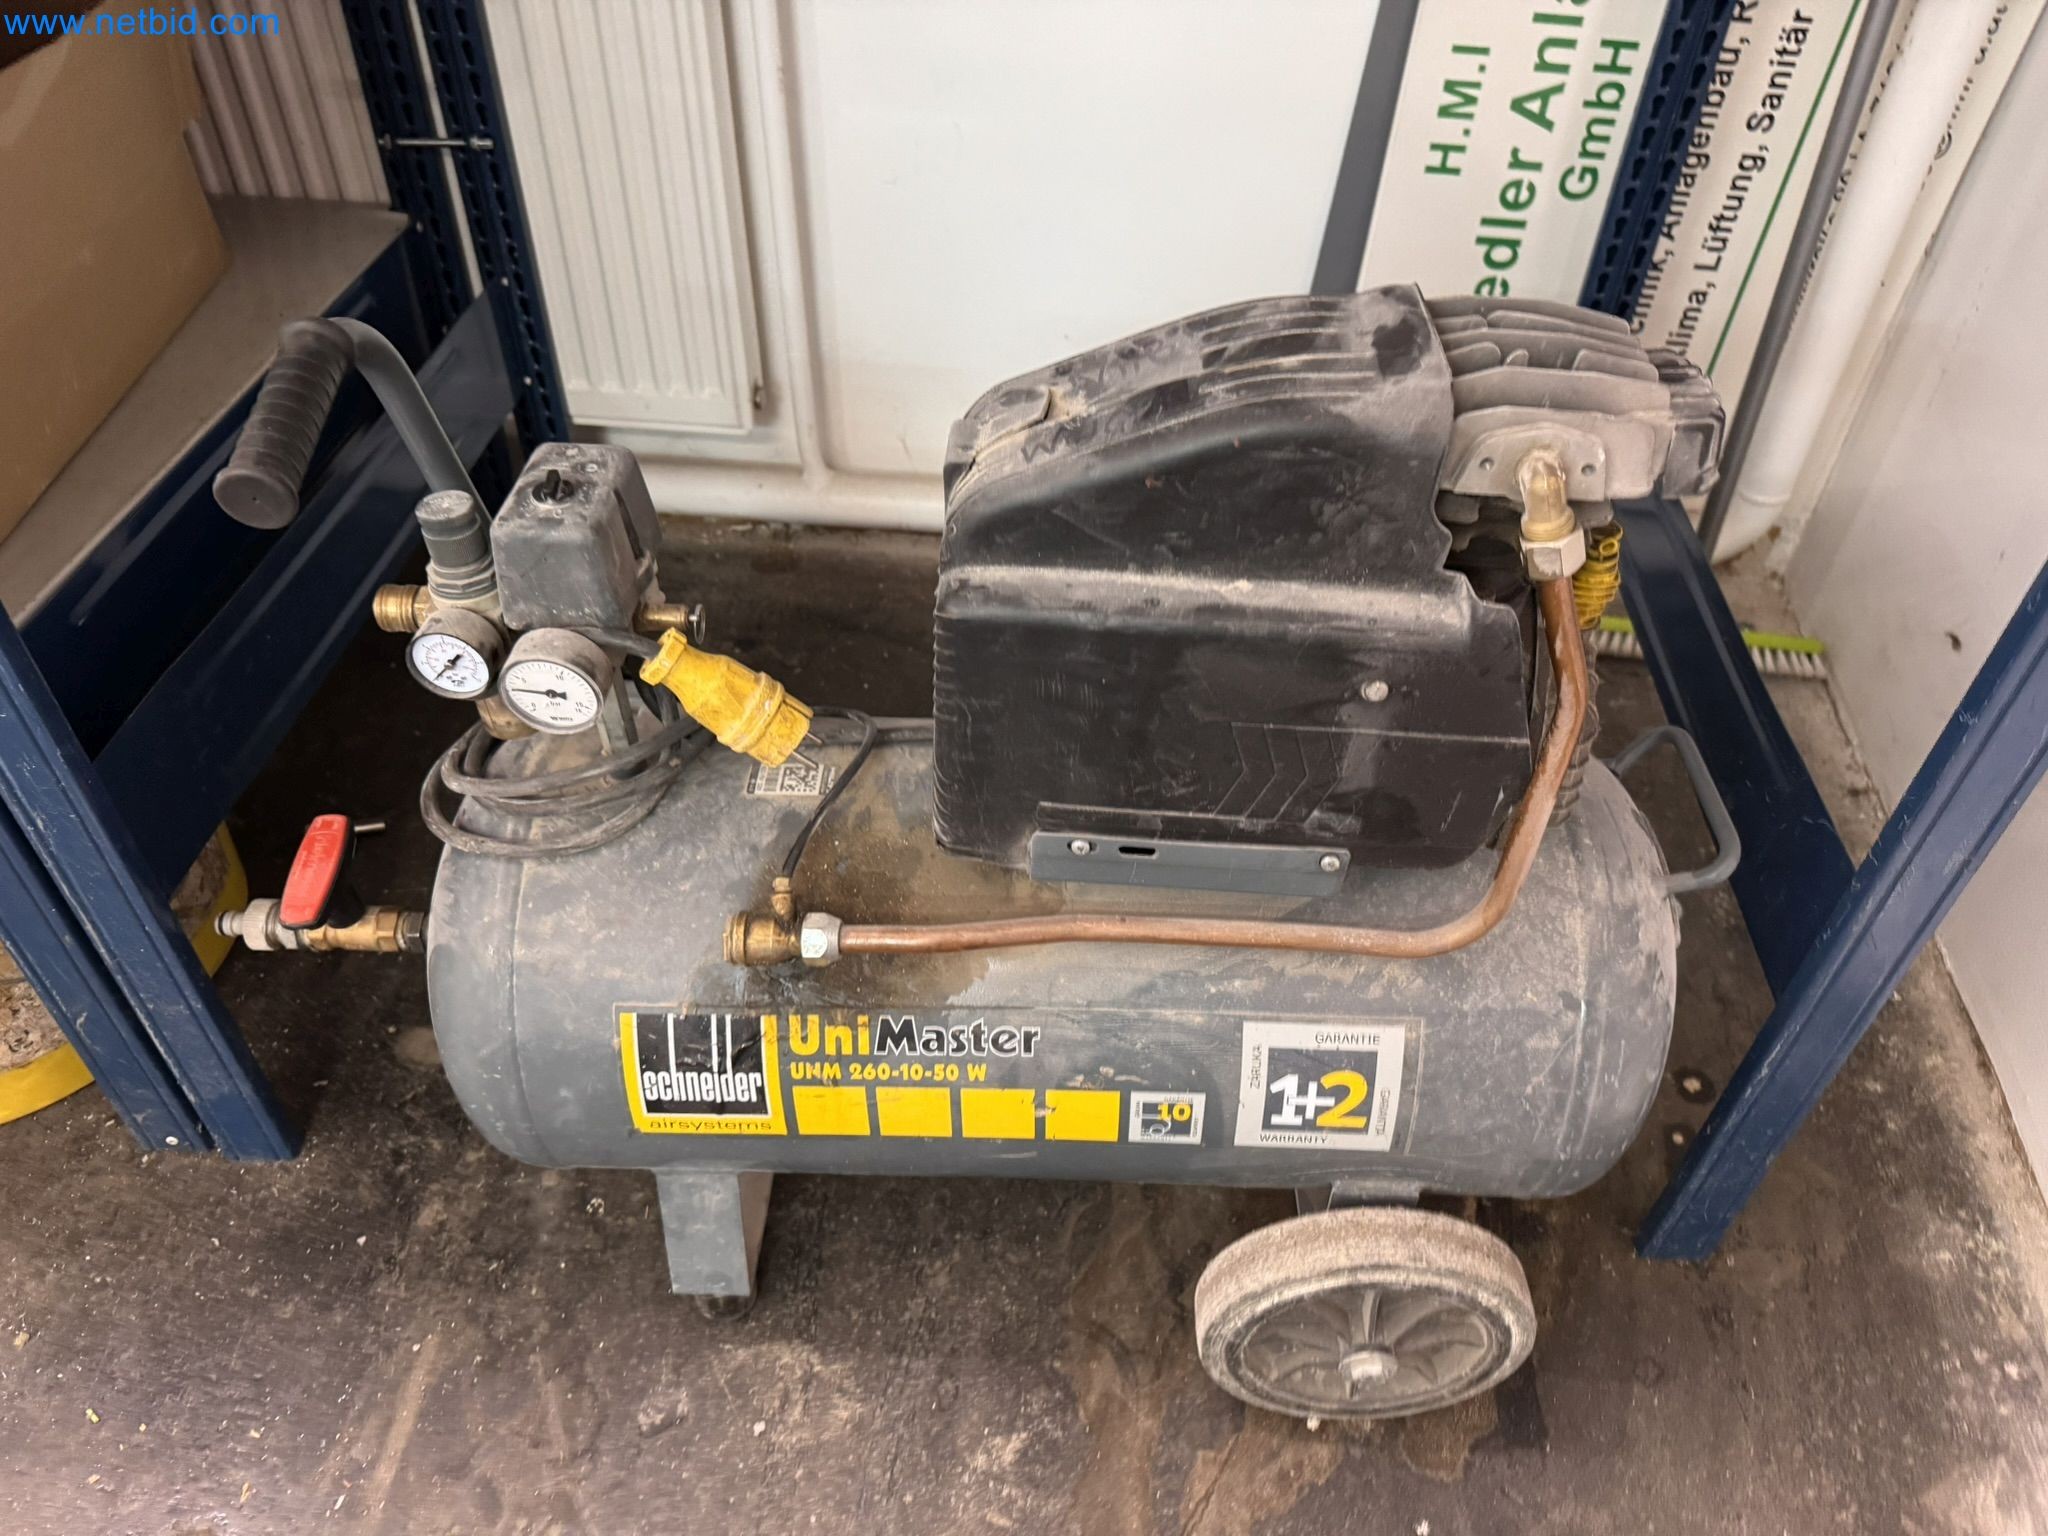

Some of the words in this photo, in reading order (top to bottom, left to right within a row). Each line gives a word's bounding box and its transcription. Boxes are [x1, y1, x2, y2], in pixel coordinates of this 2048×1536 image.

[1509, 0, 1591, 133] Anl
[1424, 44, 1491, 176] H.M.I
[1558, 39, 1641, 201] GmbH
[1694, 143, 1770, 273] Lüftung,
[1745, 8, 1815, 134] Sanitär
[789, 1014, 1041, 1058] UniMaster
[1314, 1030, 1381, 1046] GARANTIE
[850, 1063, 960, 1082] 260-10-50
[967, 1063, 988, 1082] W
[1156, 1102, 1192, 1122] 10
[1269, 1069, 1368, 1129] 1+2
[1259, 1133, 1329, 1145] WARRANTY
